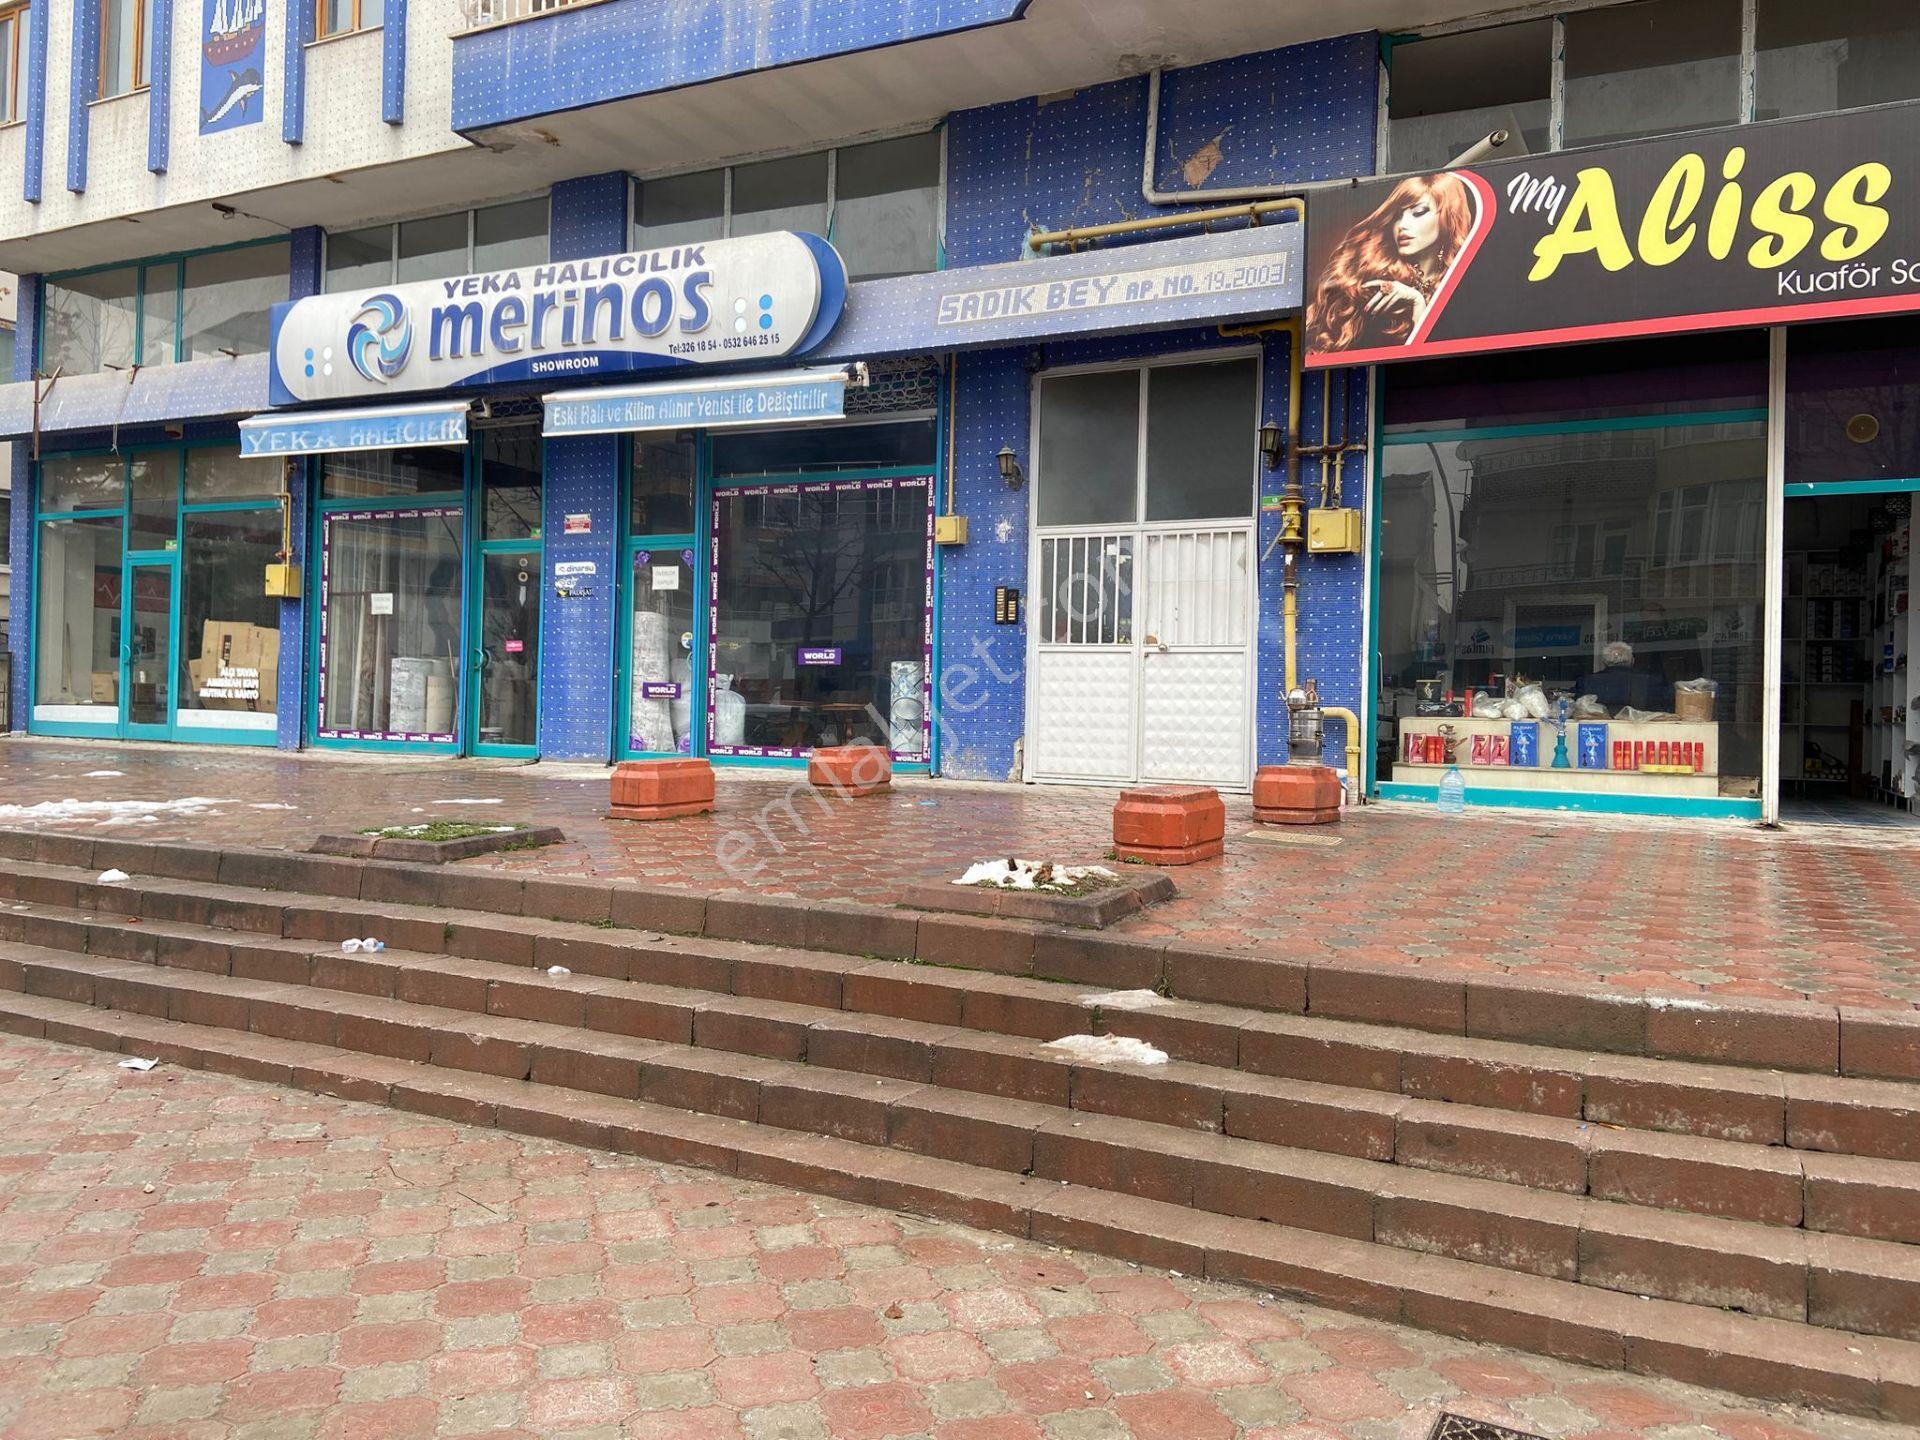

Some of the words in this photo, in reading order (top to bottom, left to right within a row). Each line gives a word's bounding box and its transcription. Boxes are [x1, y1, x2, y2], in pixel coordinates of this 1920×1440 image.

[1507, 171, 1566, 225] My
[1527, 146, 1892, 282] Aliss
[443, 271, 521, 299] YEKA
[533, 246, 706, 288] HALICILIK
[1778, 262, 1881, 295] Kuaför
[429, 271, 713, 360] merinos
[939, 287, 1033, 322] SADIK
[1046, 275, 1118, 310] BEY
[697, 341, 706, 352] 18
[708, 340, 717, 351] 54
[723, 337, 741, 349] 0532
[743, 336, 757, 347] 646
[759, 334, 769, 345] 25
[770, 333, 780, 344] 15
[532, 357, 599, 373] SHOWROOM
[553, 406, 577, 426] Eski
[608, 407, 621, 421] ve
[625, 402, 655, 421] Kilim
[697, 396, 734, 416] Yenisi
[758, 389, 828, 414] Değiştirilir
[715, 489, 739, 497] WORLD
[804, 652, 835, 660] WORLD
